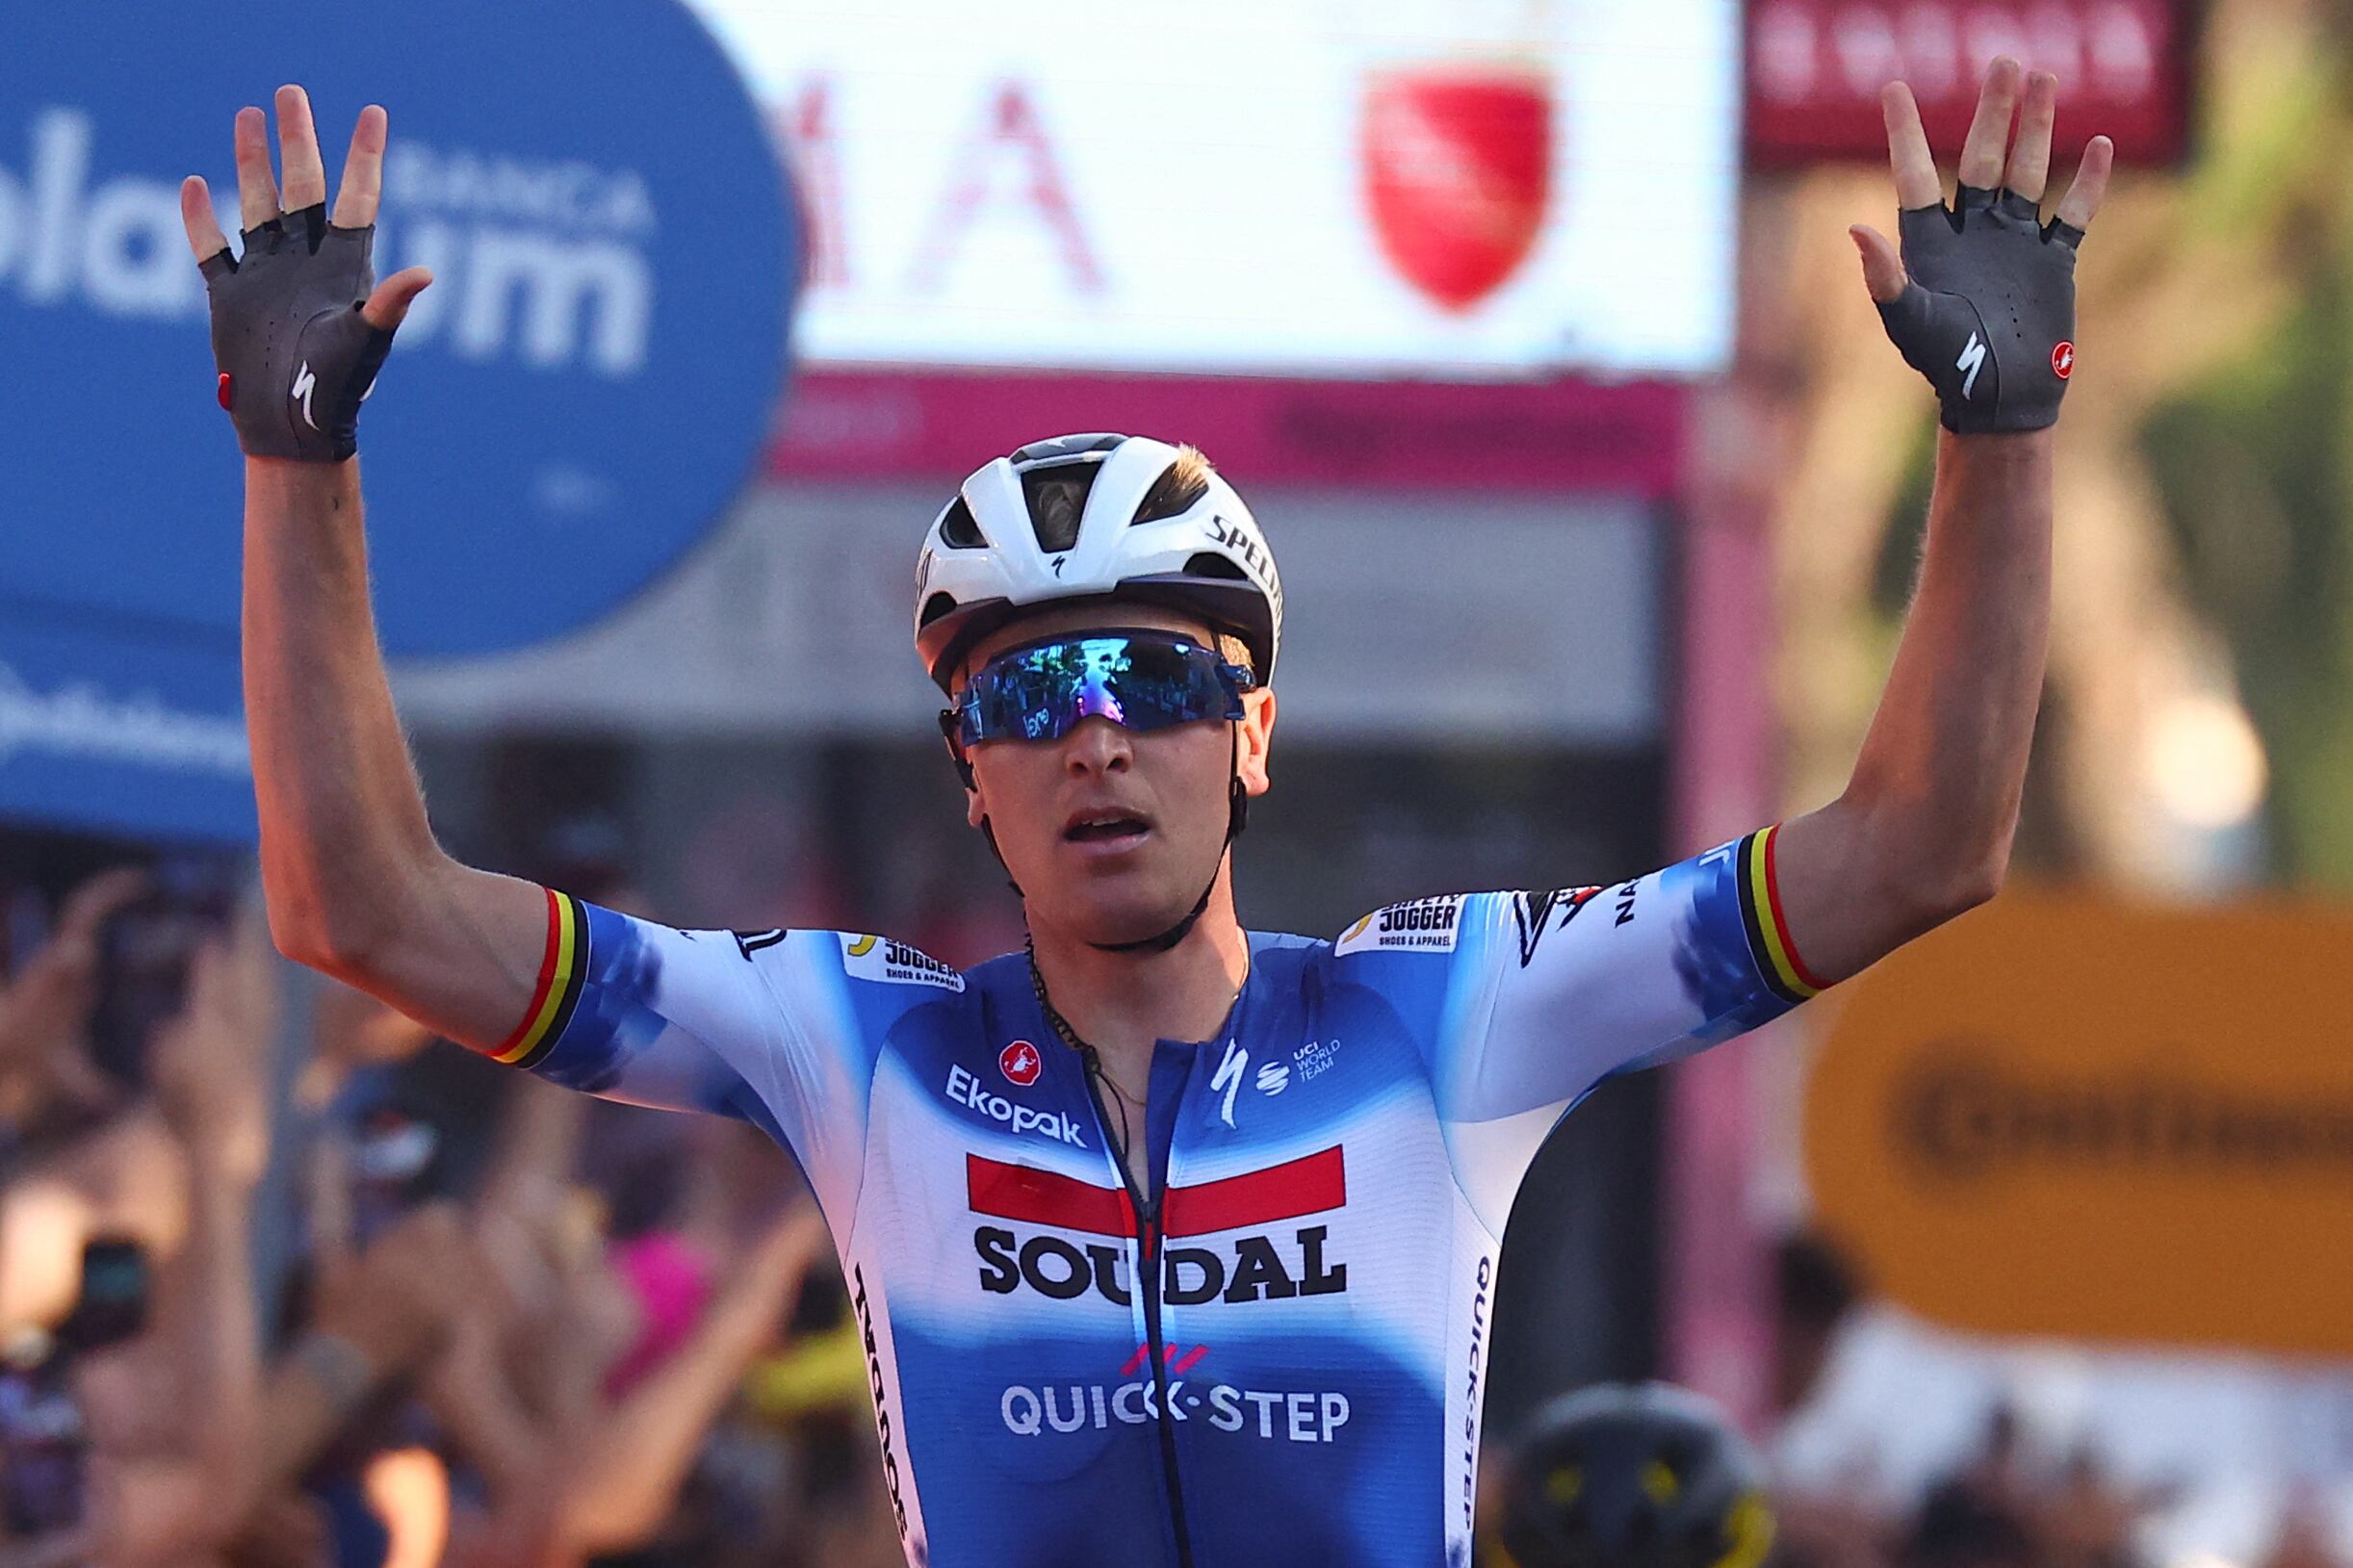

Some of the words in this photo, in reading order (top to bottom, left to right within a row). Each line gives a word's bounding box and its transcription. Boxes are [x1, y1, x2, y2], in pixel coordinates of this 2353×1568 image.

[1380, 906, 1457, 932] JOGGER
[1379, 936, 1406, 946] SHOES
[1416, 936, 1451, 946] APPAREL
[886, 968, 913, 980] SHOES
[1293, 1041, 1319, 1061] UCI
[1297, 1039, 1341, 1071] WORLD
[1300, 1056, 1334, 1083] TEAM
[945, 1063, 1089, 1148] Ekopak
[973, 1225, 1348, 1306] SOUDAL
